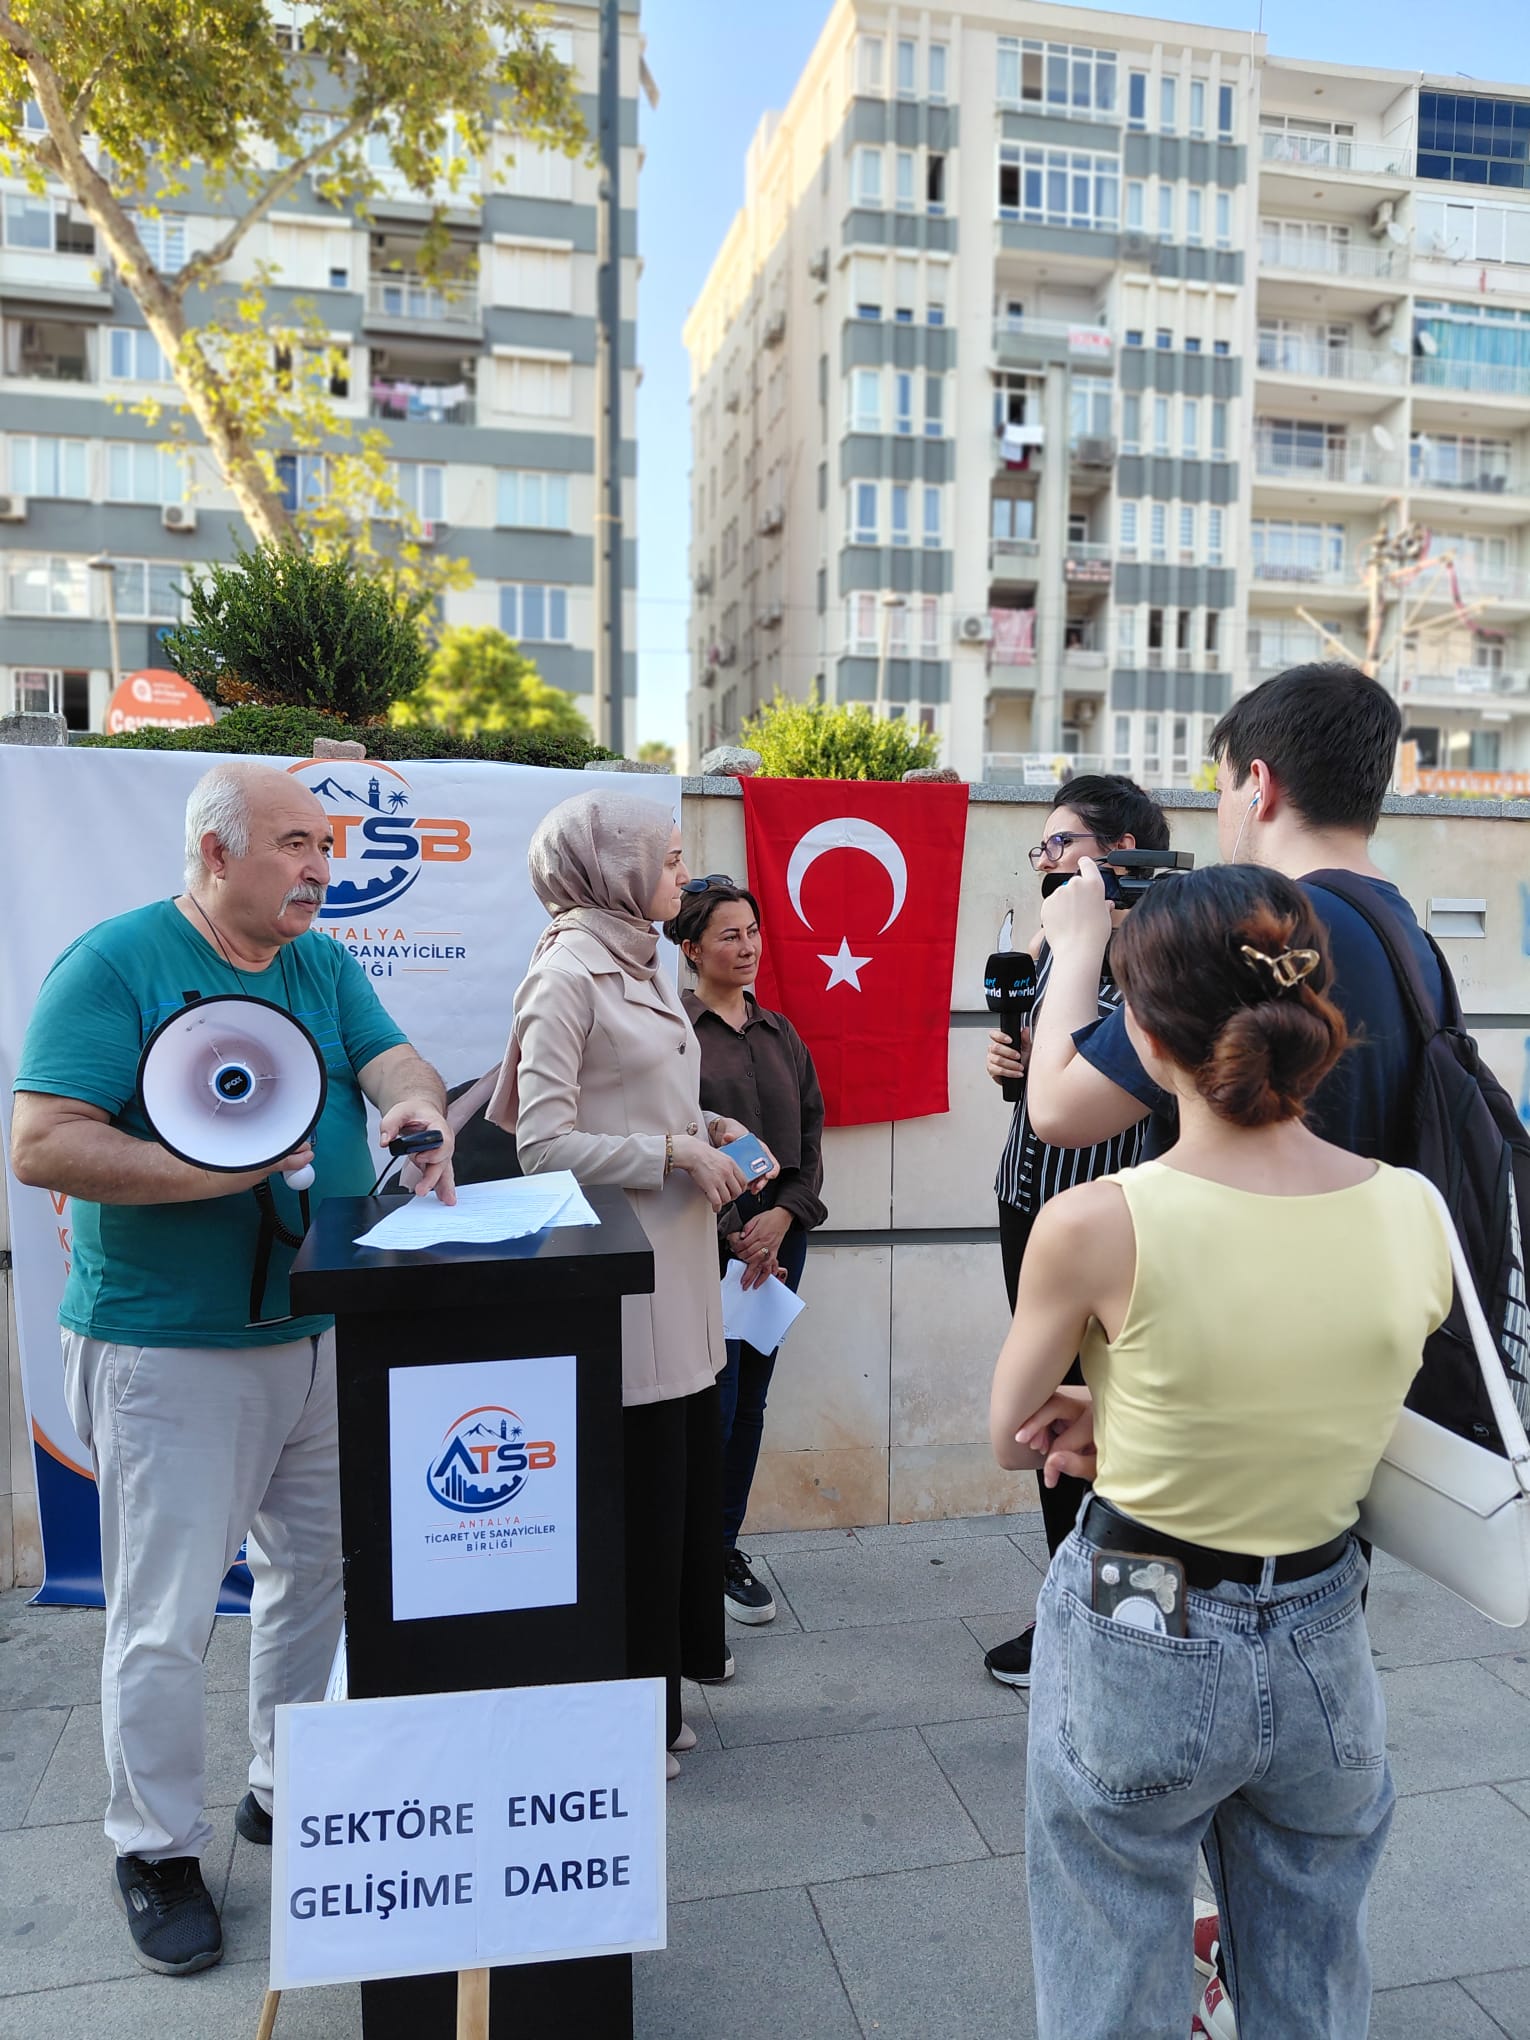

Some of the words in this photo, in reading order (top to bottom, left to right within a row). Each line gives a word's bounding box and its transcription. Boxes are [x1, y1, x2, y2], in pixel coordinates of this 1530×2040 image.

[327, 814, 473, 862] TSB
[349, 943, 466, 959] SANAYİCİLER
[1014, 977, 1030, 987] art
[1009, 986, 1035, 997] world
[433, 1435, 556, 1478] ATSB
[459, 1516, 521, 1529] ANTALYA
[424, 1532, 470, 1544] TİCARET
[473, 1529, 486, 1540] VE
[489, 1524, 556, 1539] SANAYİCİLER
[466, 1538, 513, 1552] BİRLİĞİ
[299, 1799, 474, 1849] SEKTÖRE
[508, 1788, 629, 1828] ENGEL
[289, 1870, 474, 1921] GELİŞİME
[504, 1855, 631, 1897] DARBE
